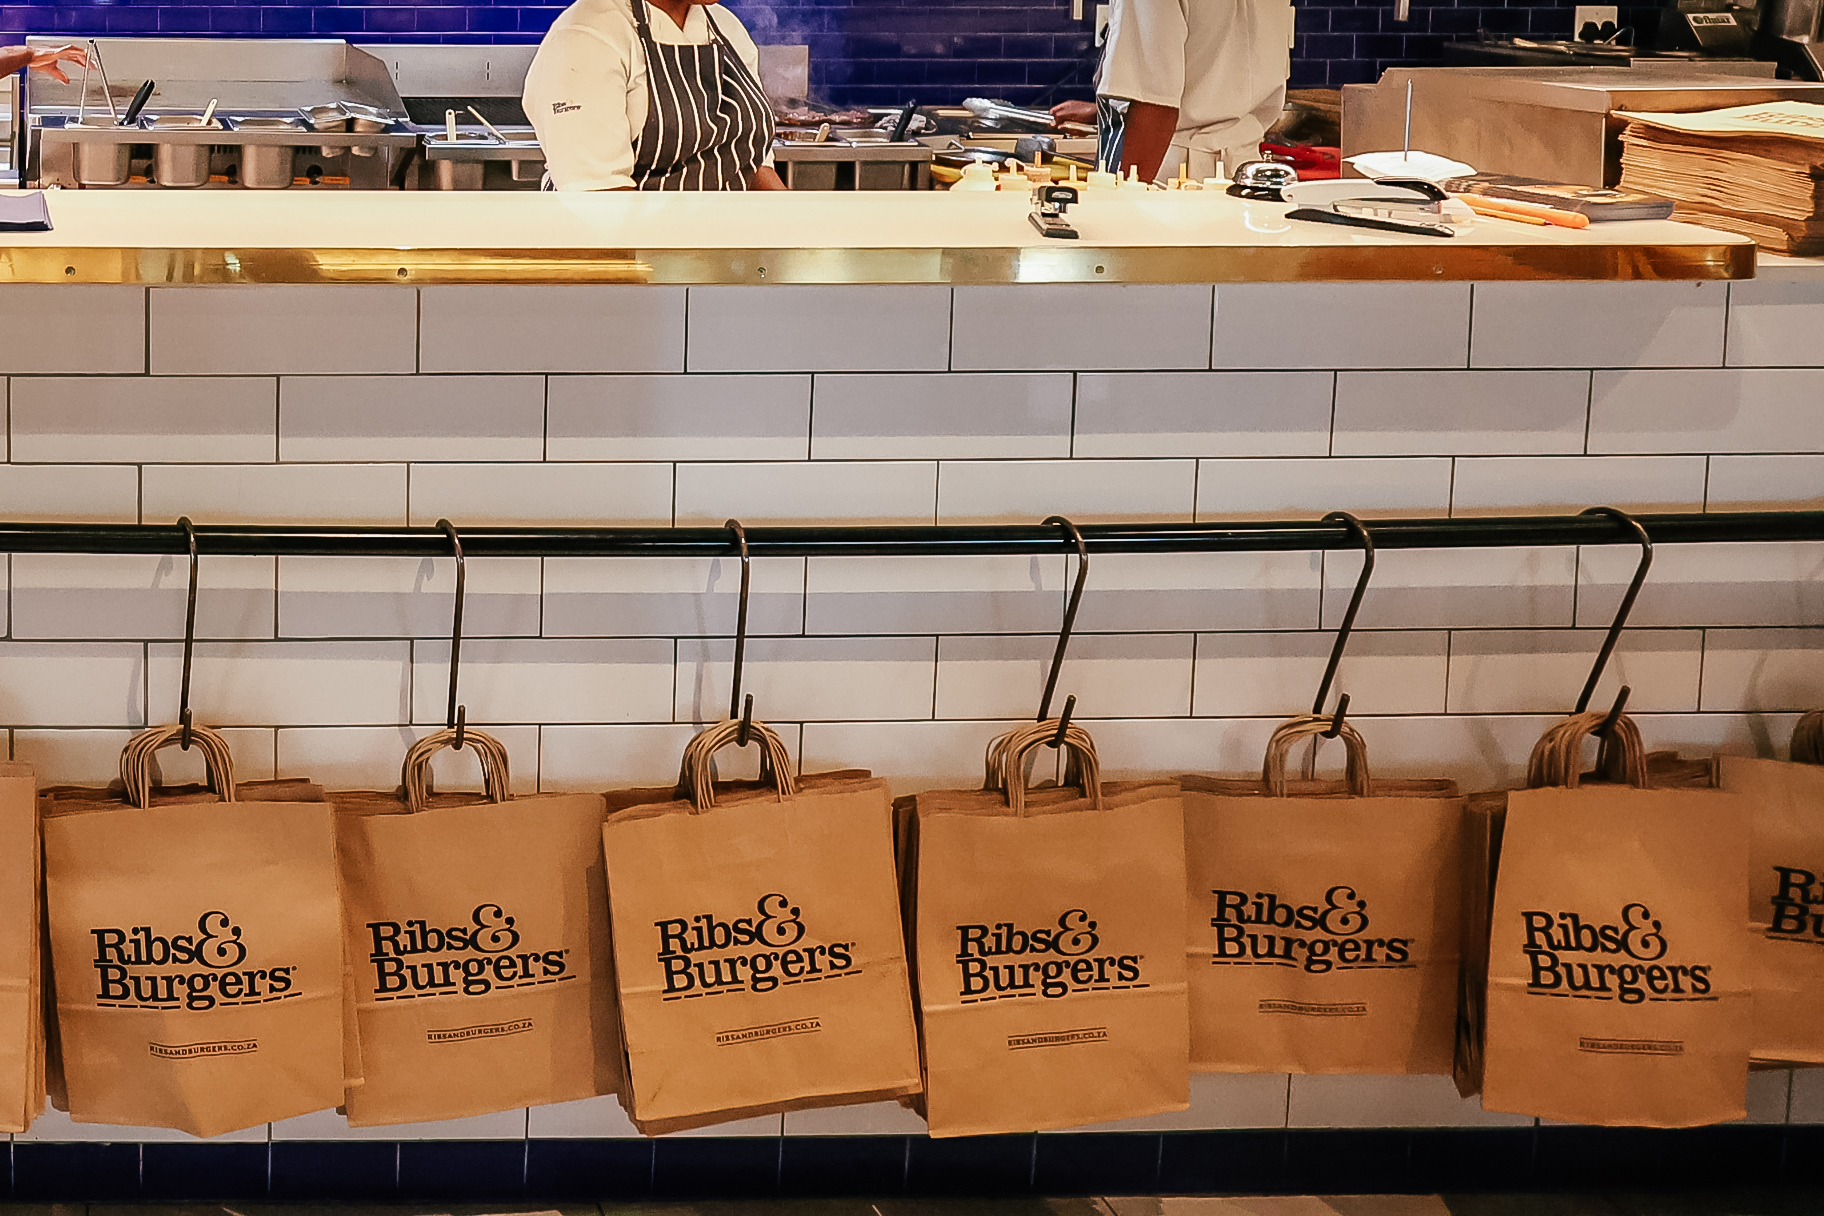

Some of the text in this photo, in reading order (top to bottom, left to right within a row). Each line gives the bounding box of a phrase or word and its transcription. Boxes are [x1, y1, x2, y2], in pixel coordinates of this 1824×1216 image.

[369, 949, 570, 996] Burgers
[658, 942, 856, 993] Burgers
[1211, 922, 1416, 974] Burgers
[94, 962, 297, 1011] Burgers
[955, 954, 1145, 998] Burgers
[1523, 948, 1712, 1004] Burgers
